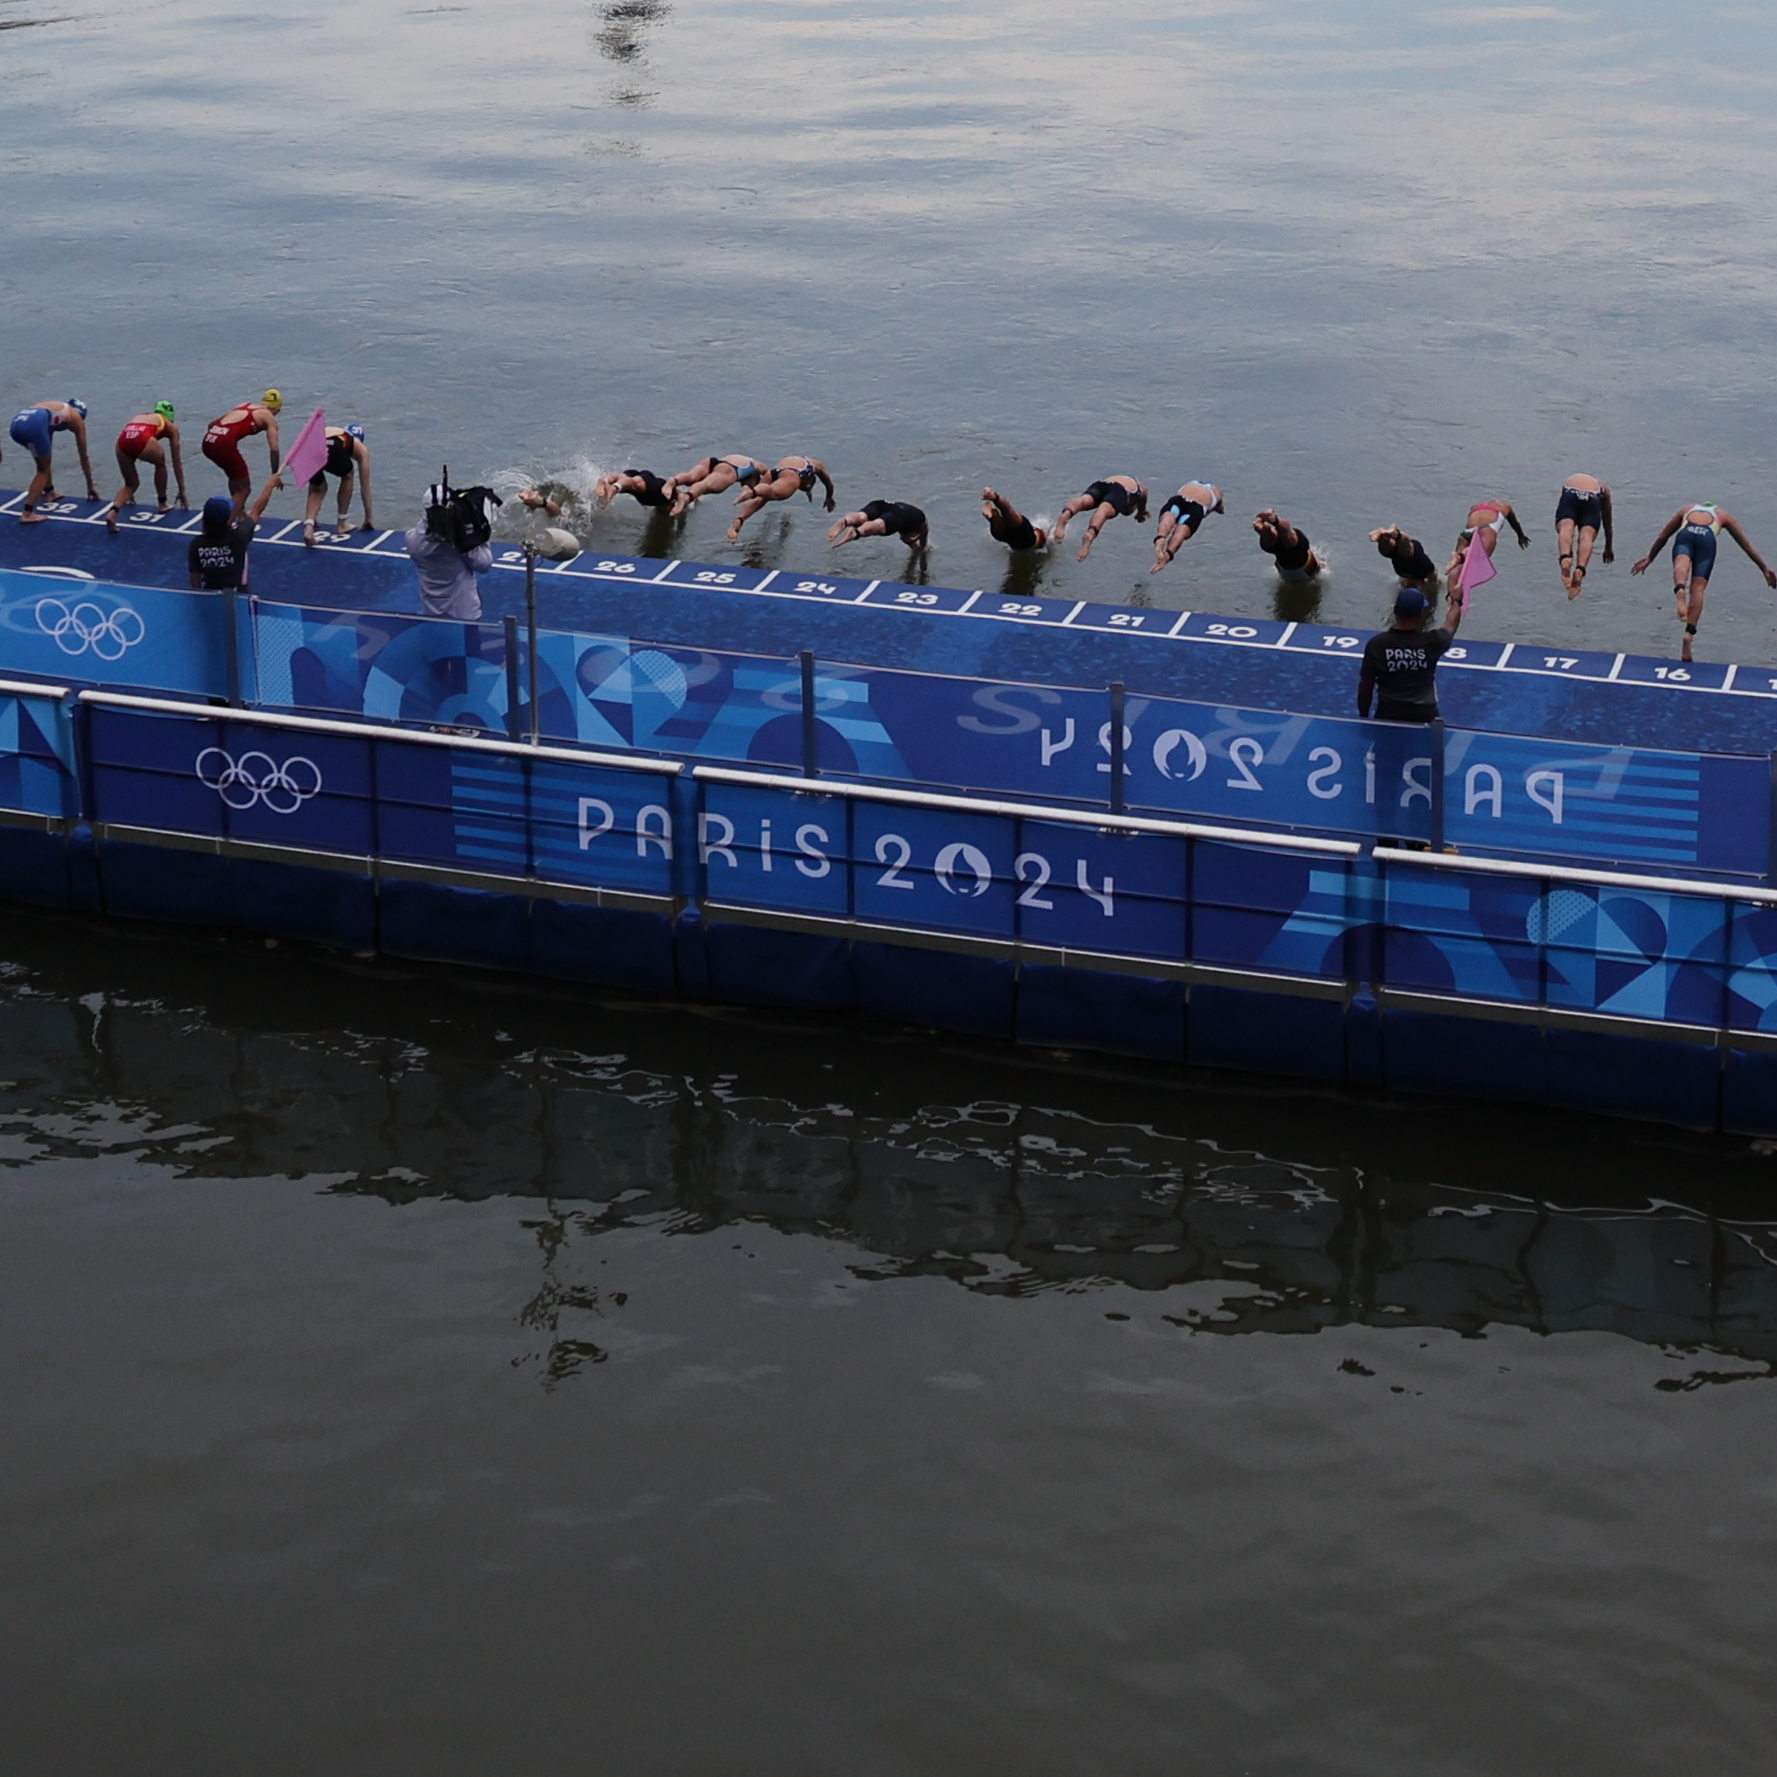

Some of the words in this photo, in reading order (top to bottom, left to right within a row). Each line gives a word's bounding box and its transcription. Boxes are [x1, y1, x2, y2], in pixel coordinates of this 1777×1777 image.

[37, 503, 77, 513] 32
[130, 512, 164, 522] 31
[198, 545, 232, 558] PARIS
[200, 556, 235, 568] 2024
[594, 562, 635, 573] 26
[694, 572, 736, 583] 25
[794, 582, 836, 594] 24
[895, 592, 938, 604] 23
[999, 603, 1042, 616] 22
[1108, 614, 1144, 626] 21
[1206, 624, 1257, 637] 20
[1324, 636, 1358, 648] 19
[1385, 648, 1426, 660] PARIS
[1387, 659, 1428, 672] 2024
[1544, 658, 1578, 669] 17
[1655, 668, 1690, 680] 16
[875, 833, 1115, 918] 2024
